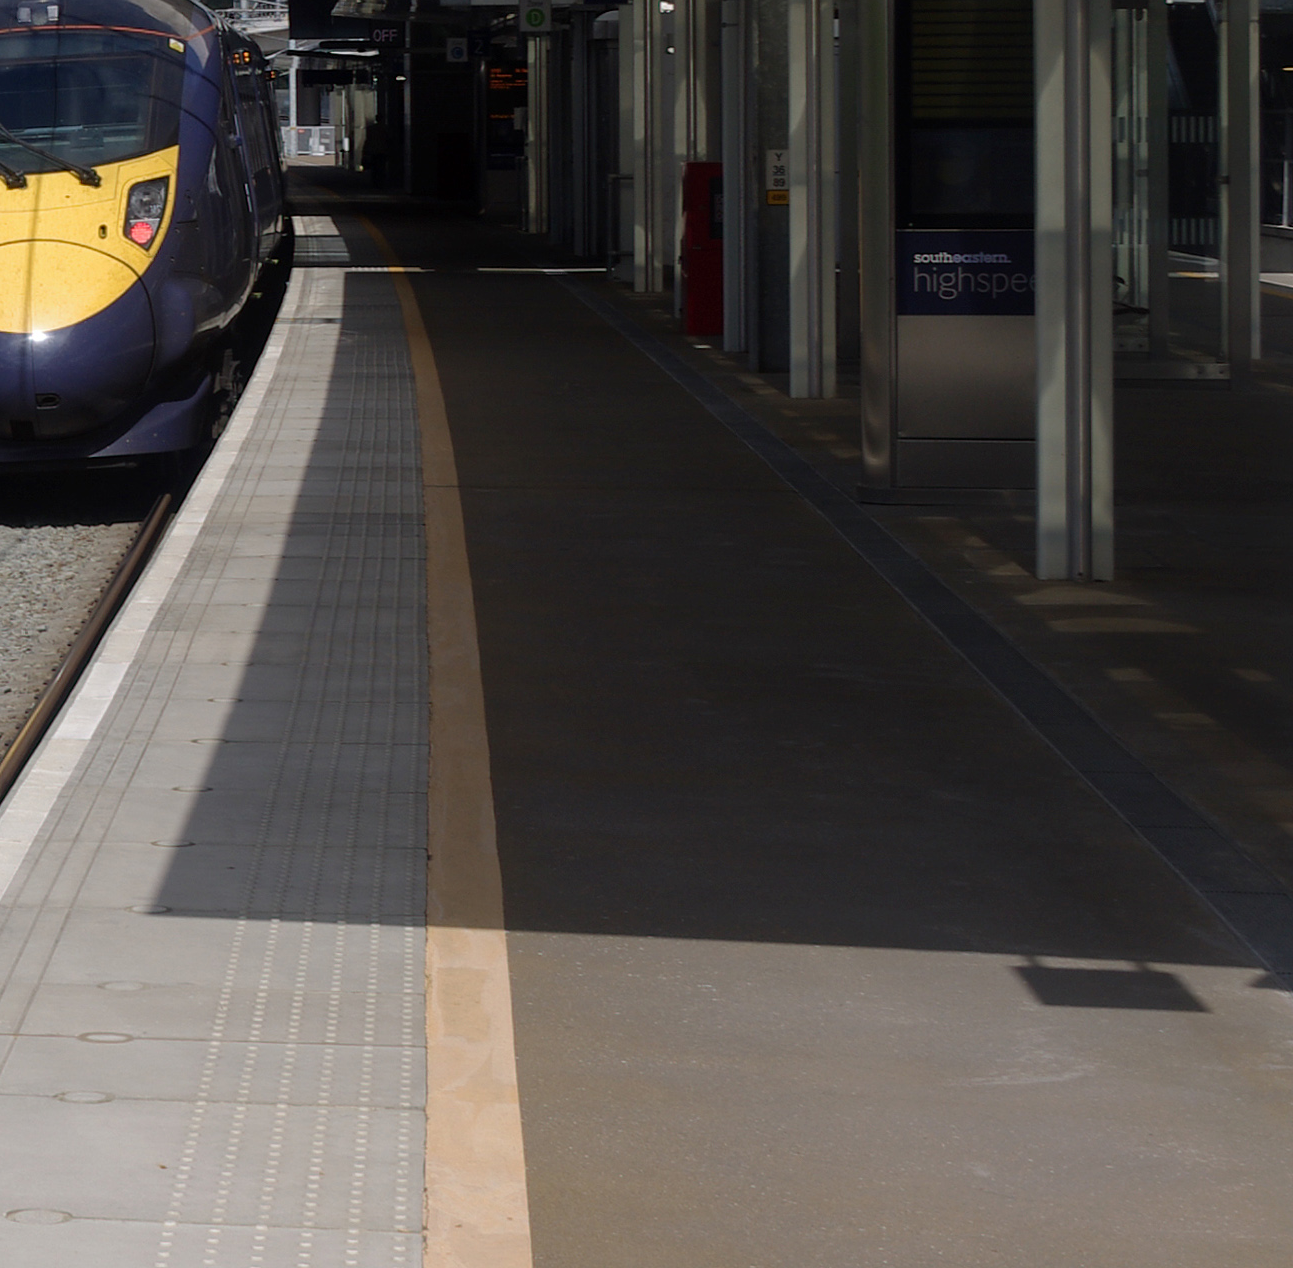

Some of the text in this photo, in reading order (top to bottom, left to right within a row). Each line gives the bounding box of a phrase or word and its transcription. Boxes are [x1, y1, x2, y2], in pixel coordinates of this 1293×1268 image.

[531, 12, 541, 24] D
[373, 28, 398, 43] OFF
[474, 39, 484, 54] 2
[774, 152, 783, 161] Y
[772, 165, 785, 174] 36
